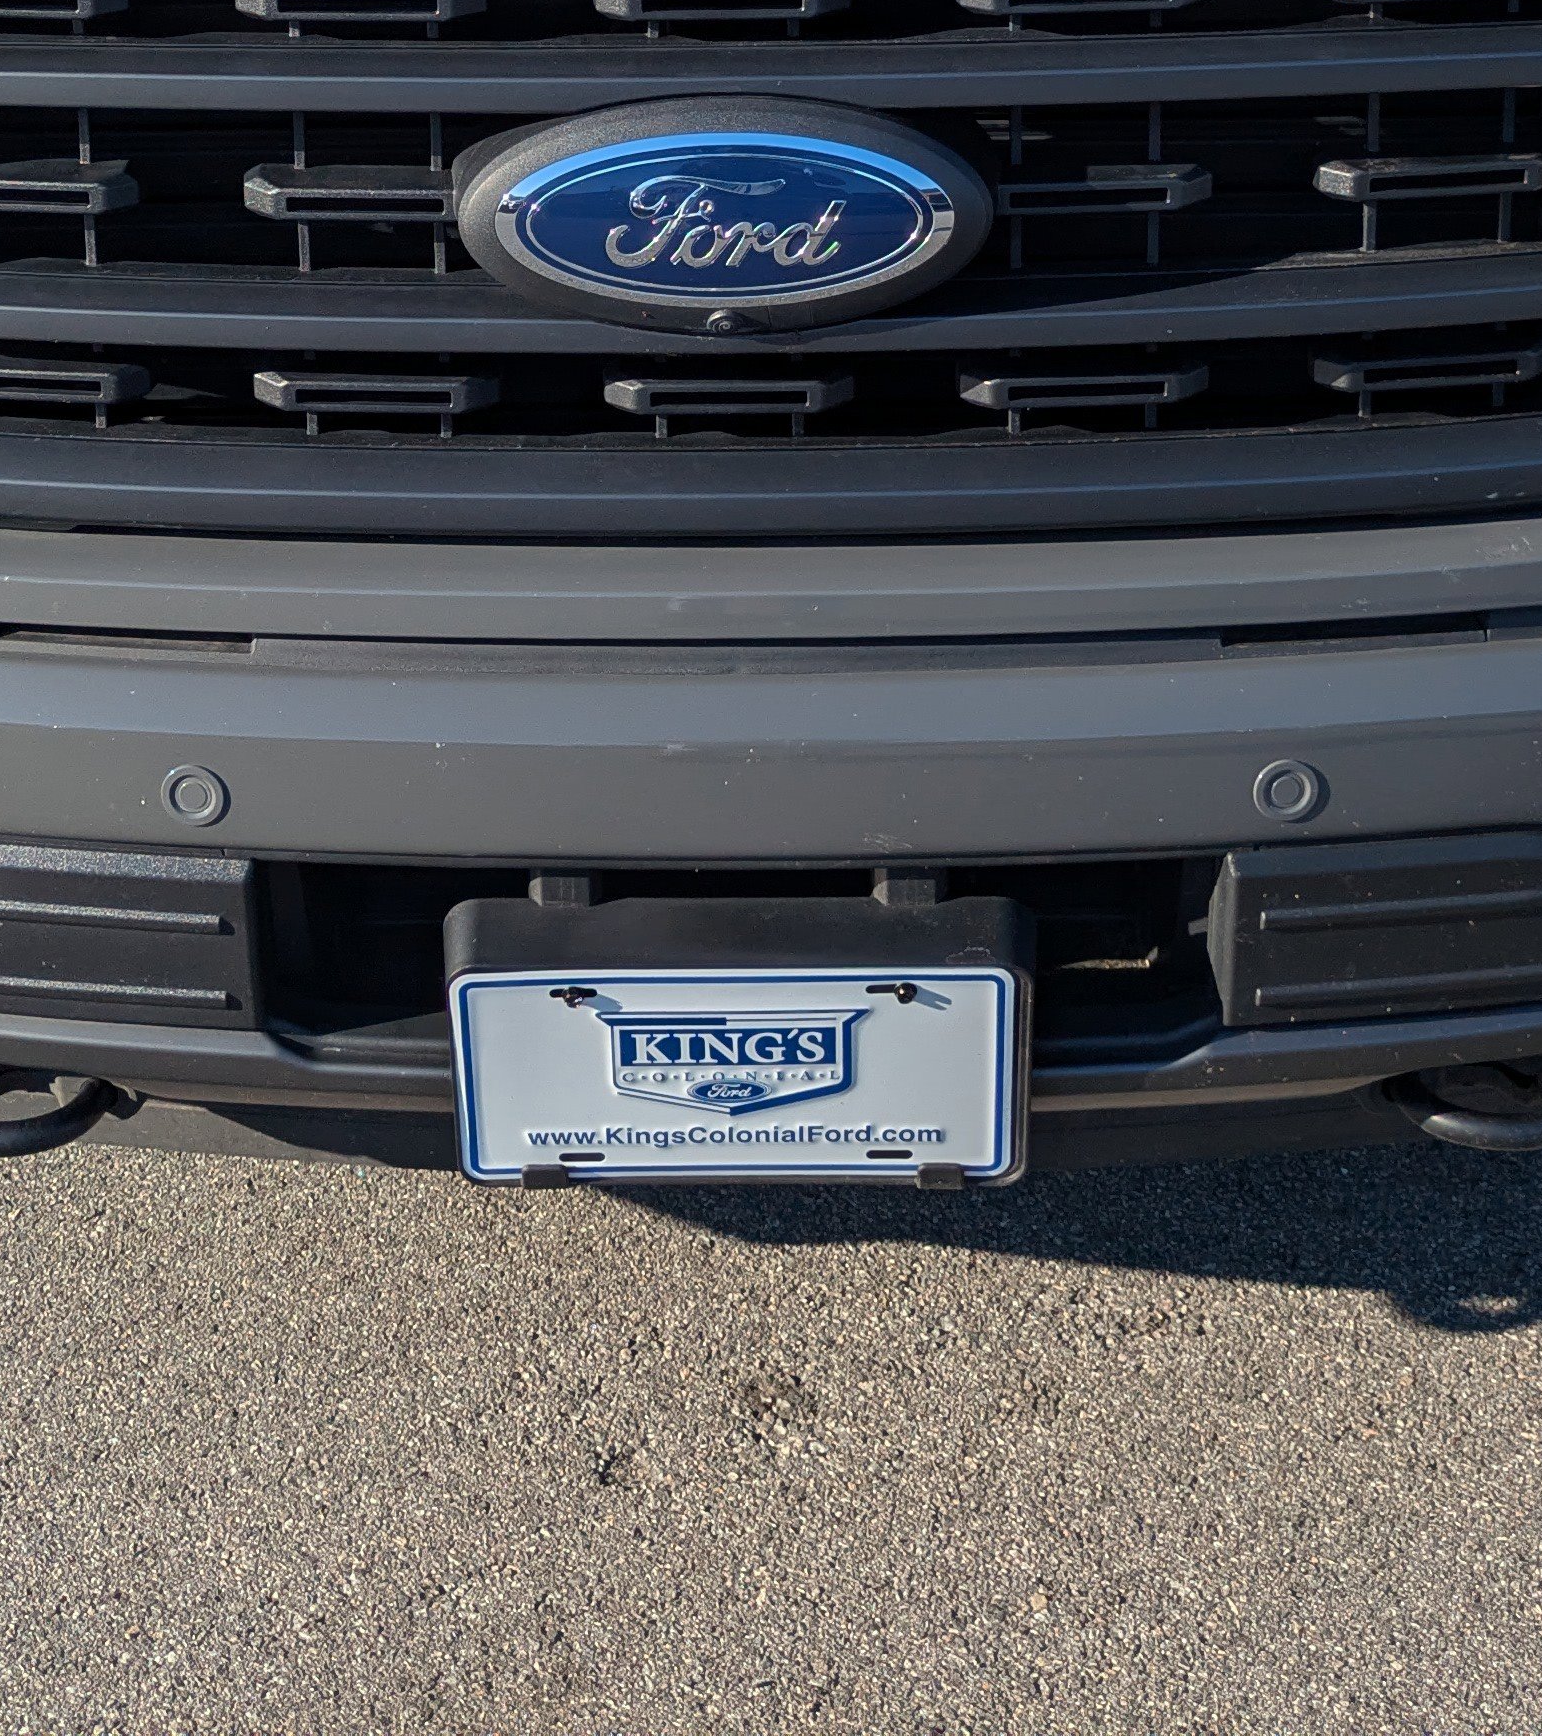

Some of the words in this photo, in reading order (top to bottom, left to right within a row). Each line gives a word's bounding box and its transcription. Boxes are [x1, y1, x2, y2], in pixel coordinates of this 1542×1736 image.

[605, 175, 847, 268] Ford
[631, 1028, 826, 1064] KING'S
[707, 1082, 753, 1099] Ford
[528, 1125, 943, 1148] www.KingsColonialFord.com
